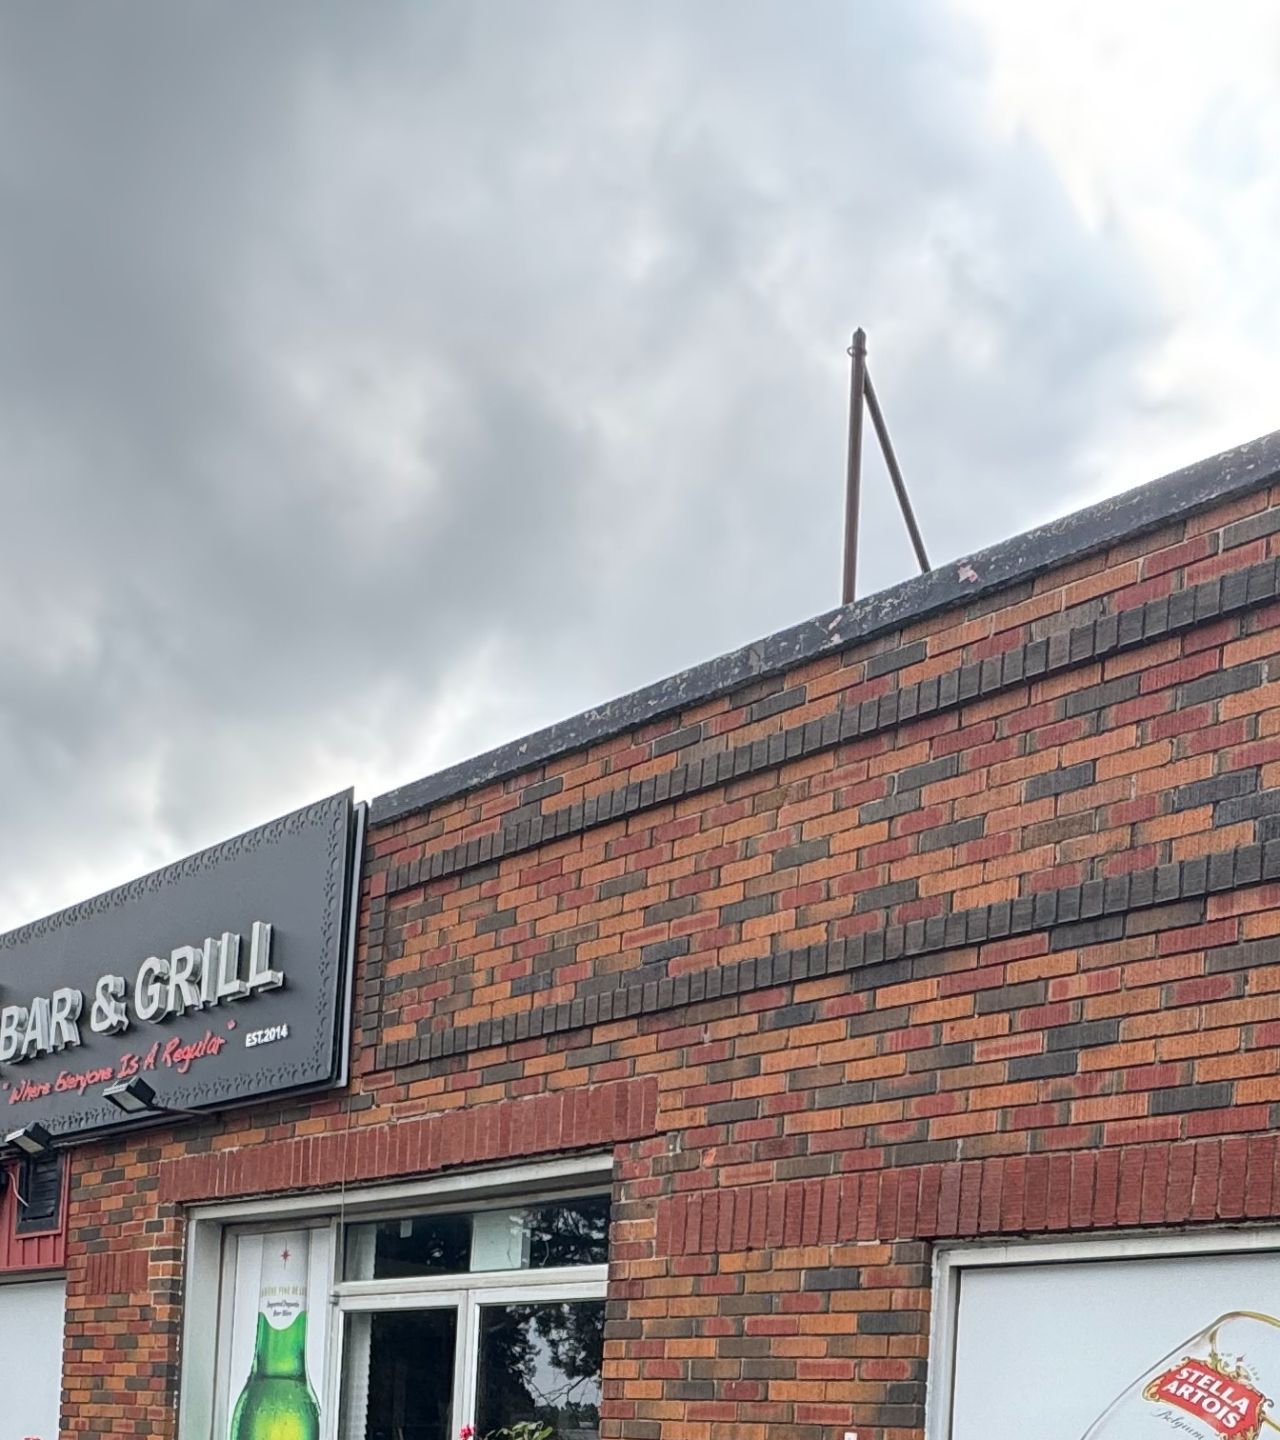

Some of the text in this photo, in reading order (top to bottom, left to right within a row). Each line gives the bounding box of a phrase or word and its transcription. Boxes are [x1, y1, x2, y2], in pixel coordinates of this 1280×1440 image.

[90, 974, 129, 1036] &
[135, 921, 284, 1023] GRILL
[245, 1023, 288, 1048] EST.2014
[54, 1066, 114, 1096] Everyone
[117, 1053, 140, 1079] Is
[143, 1040, 161, 1070] A
[1162, 1379, 1241, 1429] ARTOIS
[1175, 1367, 1250, 1415] STELLA
[1151, 1407, 1205, 1440] Belgium
